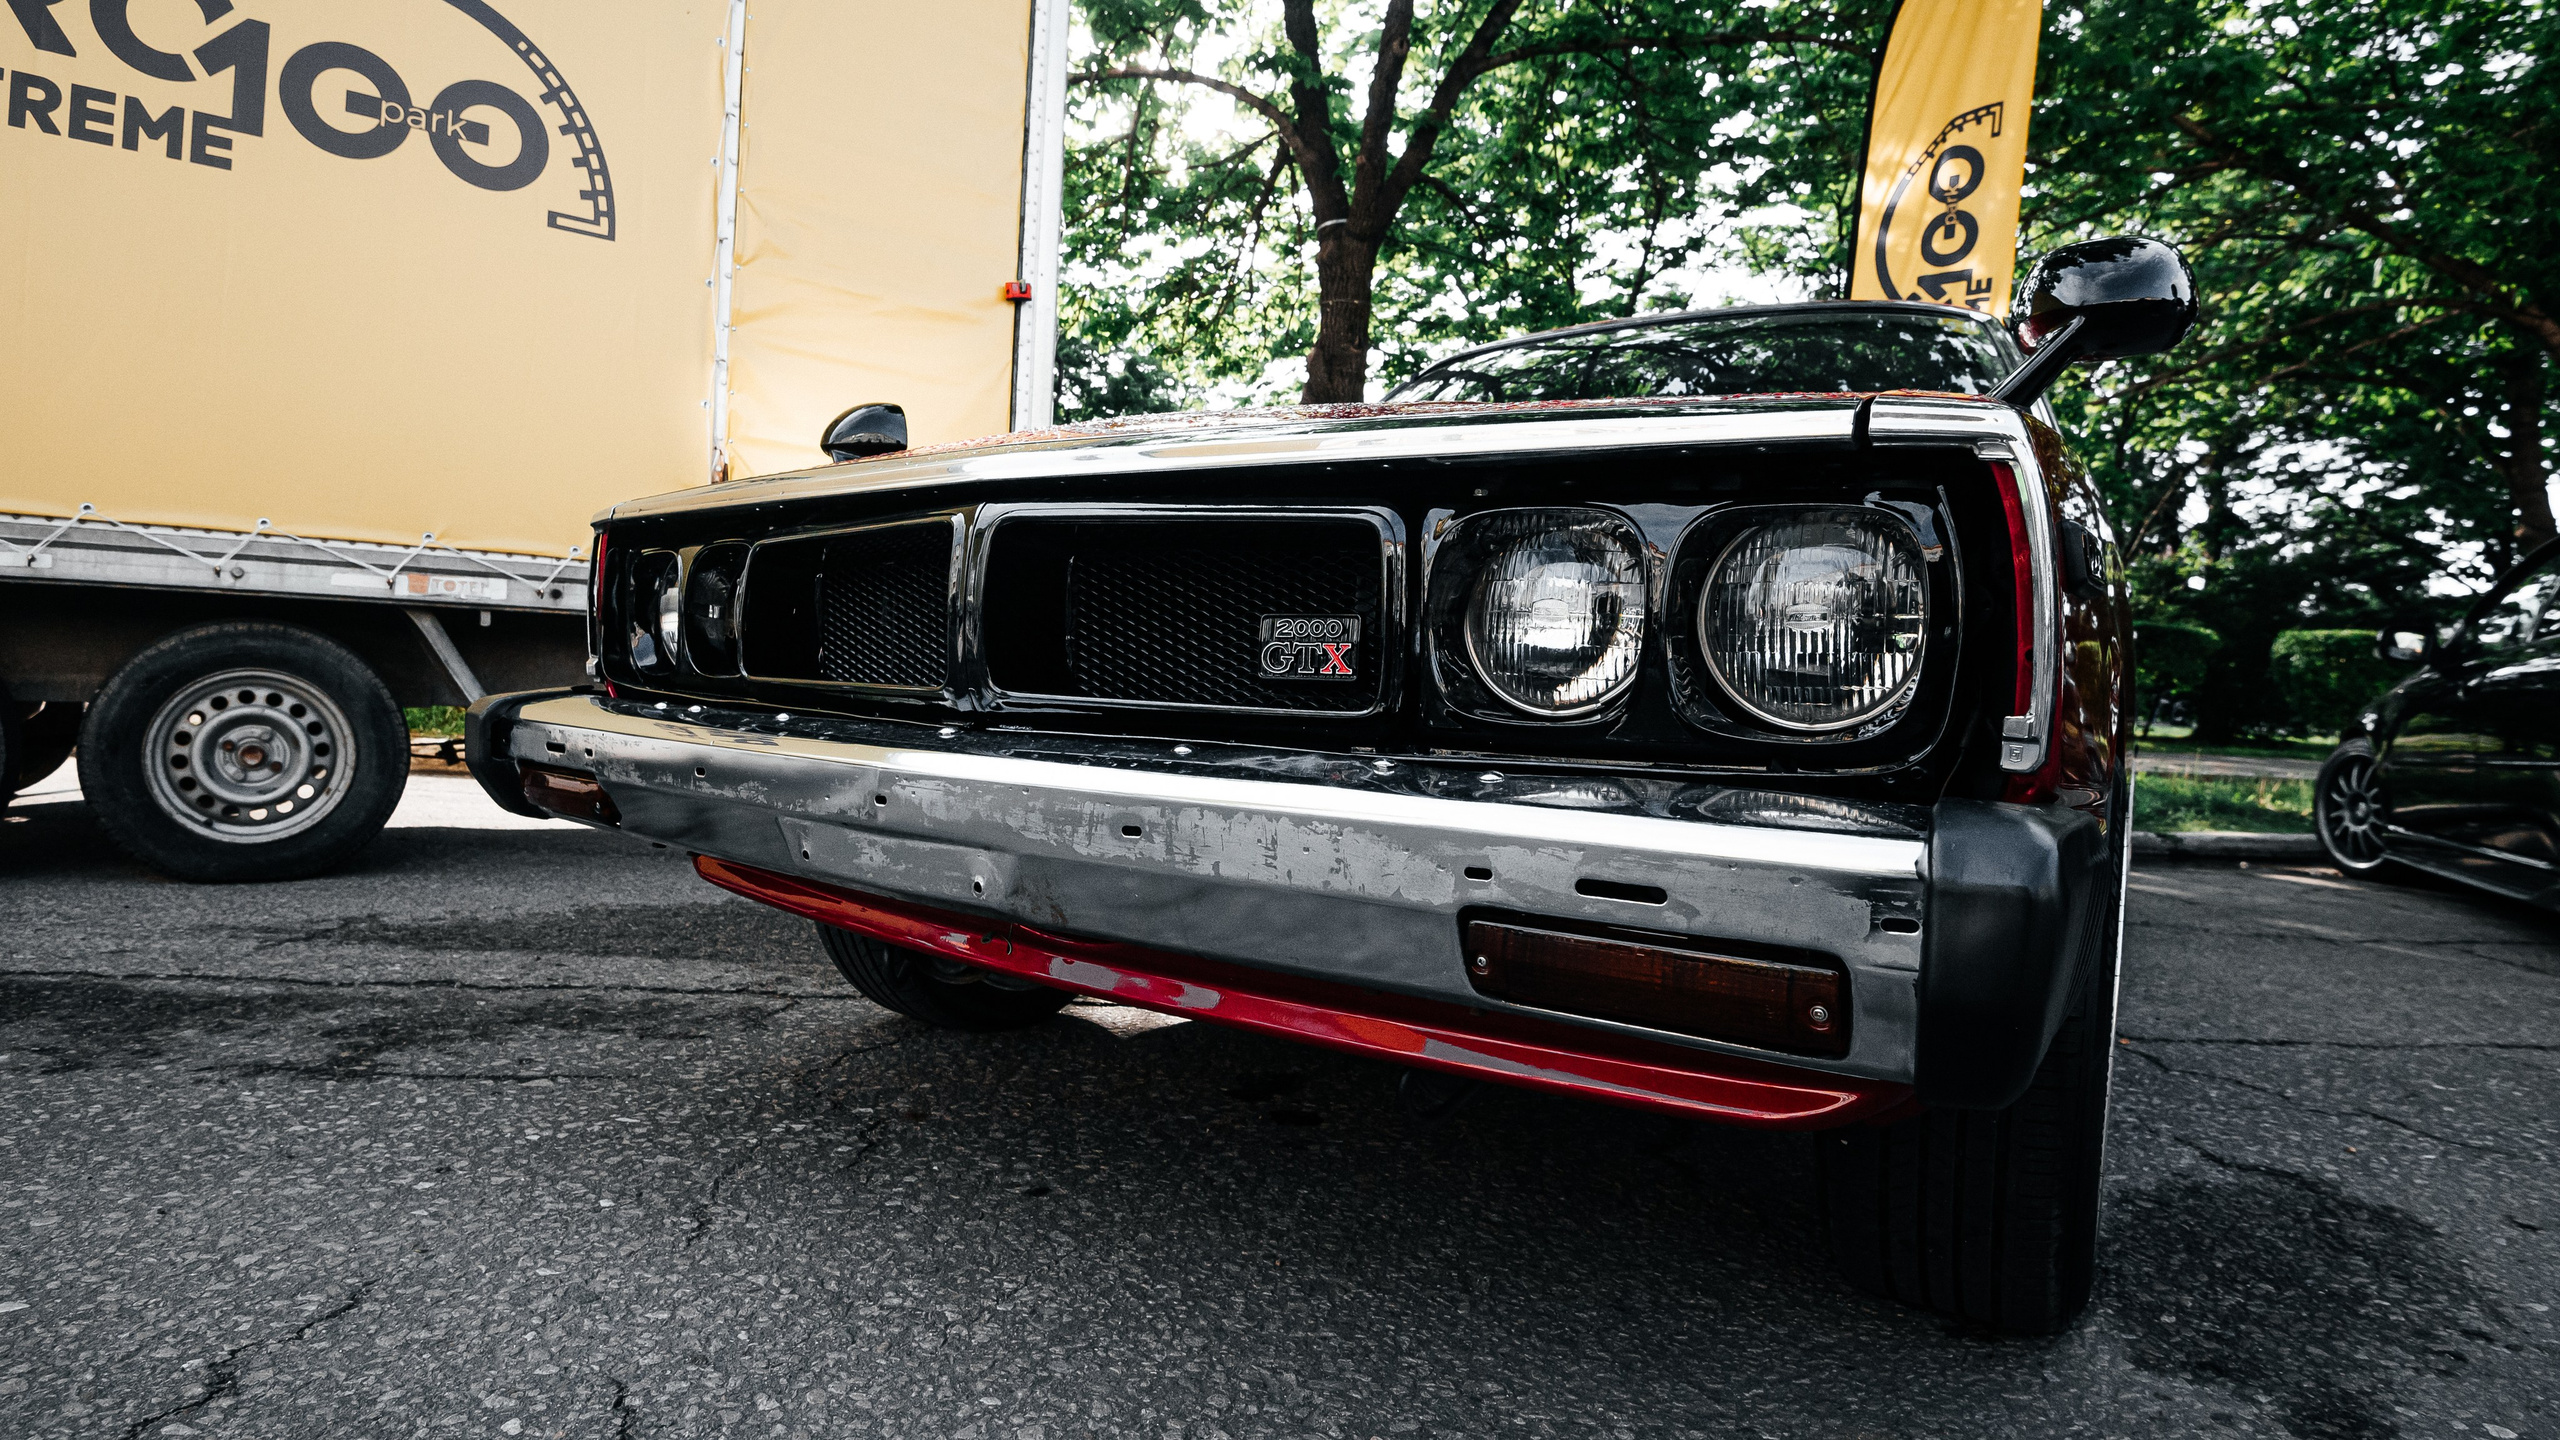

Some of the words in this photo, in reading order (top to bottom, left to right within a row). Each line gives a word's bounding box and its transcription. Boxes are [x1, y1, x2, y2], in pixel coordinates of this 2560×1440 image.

[0, 67, 233, 171] REME
[379, 99, 467, 141] park
[1275, 618, 1343, 638] 2000
[1261, 641, 1353, 675] GTX
